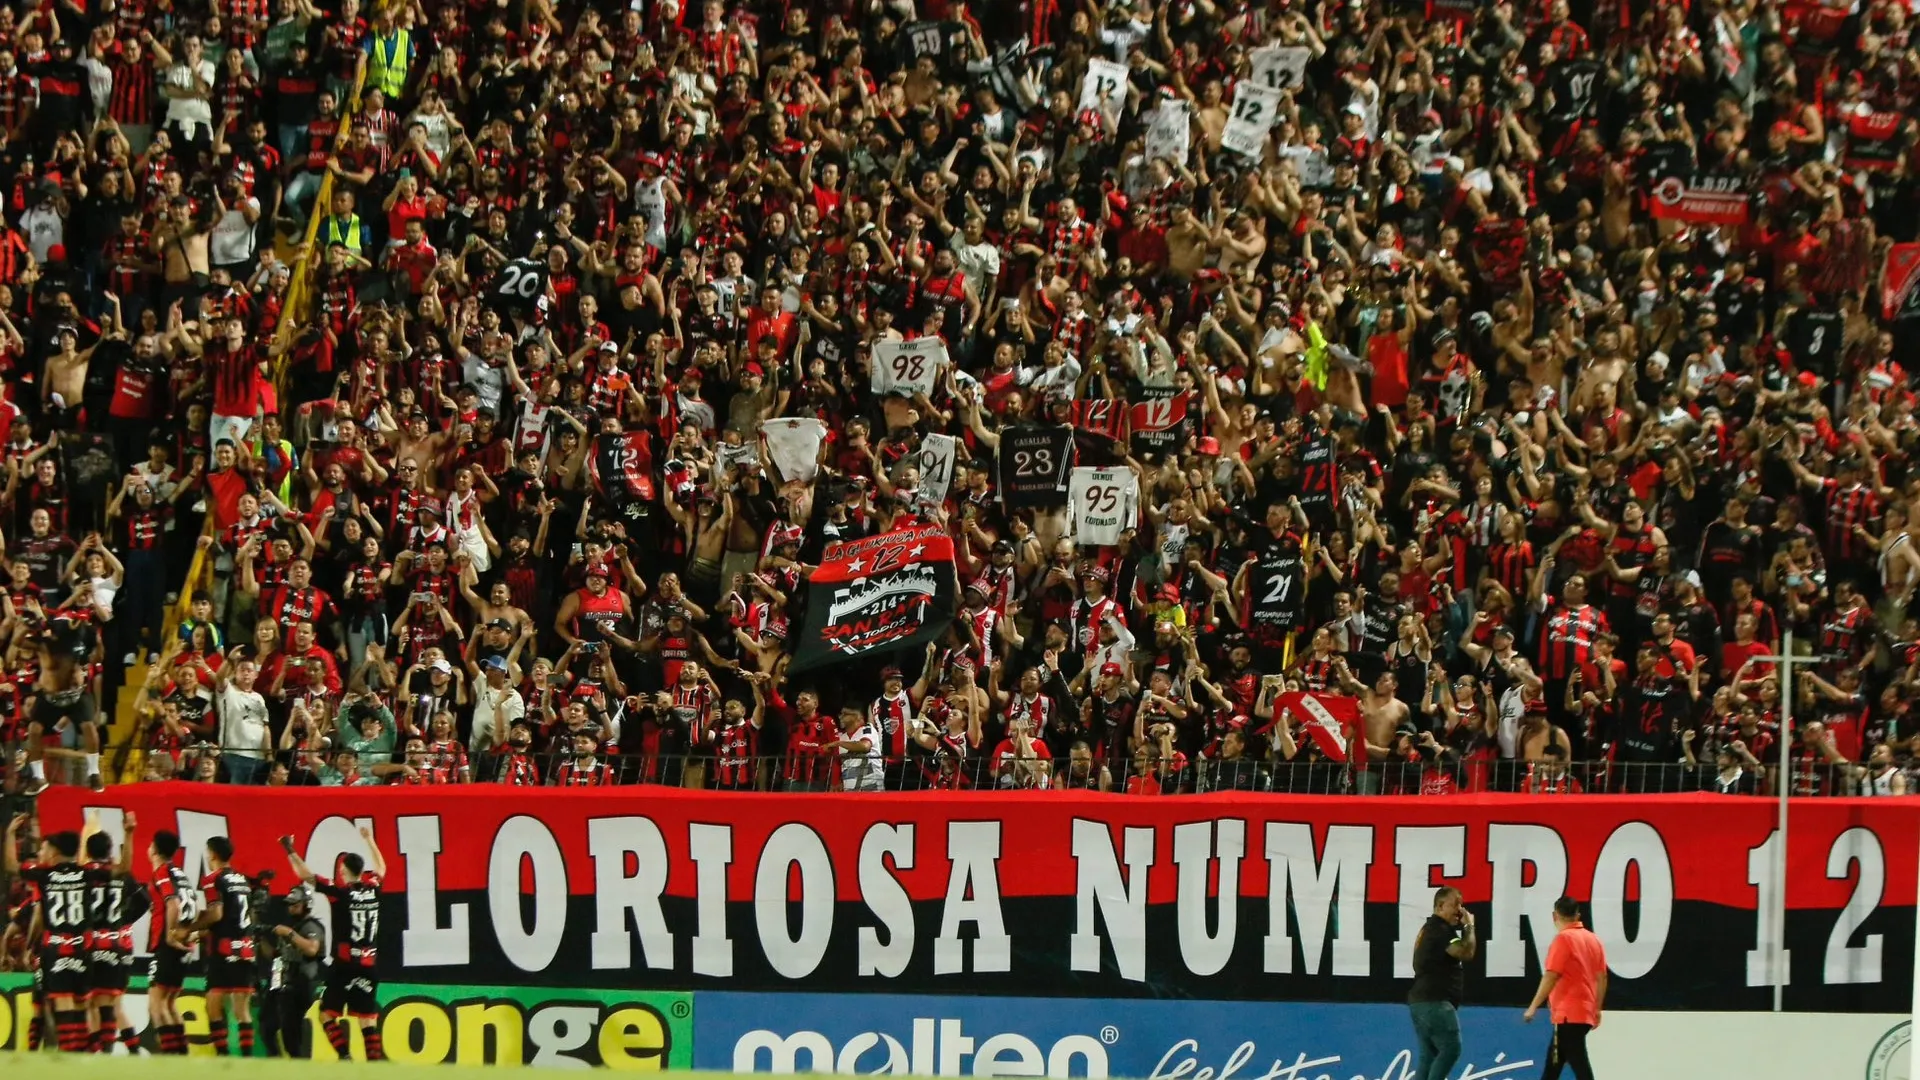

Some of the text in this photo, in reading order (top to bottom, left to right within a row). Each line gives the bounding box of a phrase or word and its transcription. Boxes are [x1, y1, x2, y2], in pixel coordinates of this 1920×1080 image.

[1235, 97, 1263, 124] 12
[499, 265, 540, 299] 20
[892, 354, 927, 382] 98
[1087, 398, 1112, 420] 12
[1146, 398, 1172, 427] 12
[607, 448, 639, 470] 12
[921, 450, 948, 484] 91
[1013, 449, 1054, 477] 23
[1085, 485, 1121, 513] 95
[823, 547, 845, 562] LA
[870, 545, 906, 574] 12
[1261, 573, 1292, 604] 21
[869, 595, 898, 616] 214
[863, 615, 907, 640] TODOS
[47, 890, 86, 928] 28
[90, 887, 123, 924] 22
[303, 814, 1013, 980] GLORIOSA
[1070, 817, 1675, 983] NUMERO
[1745, 825, 1887, 988] 12
[349, 909, 380, 943] 97
[732, 1017, 1109, 1078] molten
